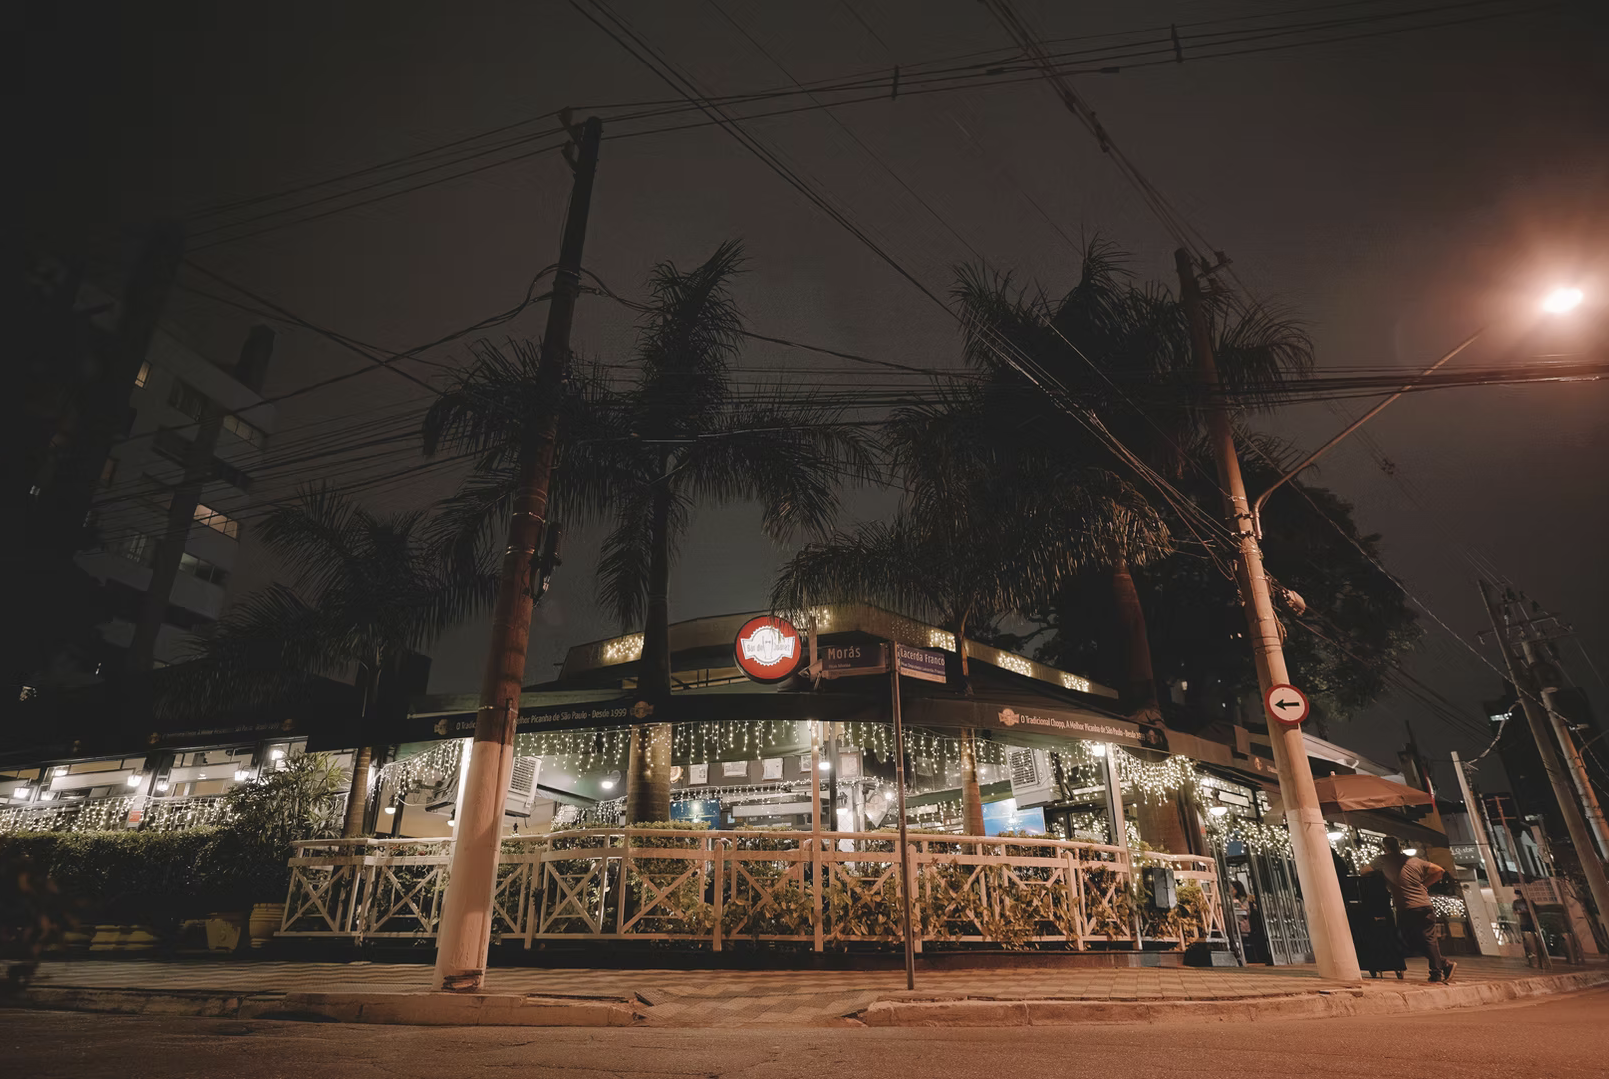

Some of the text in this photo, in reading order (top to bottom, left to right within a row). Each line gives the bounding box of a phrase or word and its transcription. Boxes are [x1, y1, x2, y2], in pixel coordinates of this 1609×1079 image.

[828, 645, 861, 660] Morás
[900, 648, 923, 662] Lacerda
[924, 653, 946, 666] Franco
[531, 713, 552, 723] Picanha
[553, 712, 560, 721] de
[561, 711, 571, 720] São
[572, 710, 588, 720] Paulo
[592, 708, 610, 719] Desde
[610, 707, 627, 718] 1999
[1020, 714, 1026, 724] O
[1025, 715, 1050, 727] Tradicional
[1065, 720, 1070, 728] A
